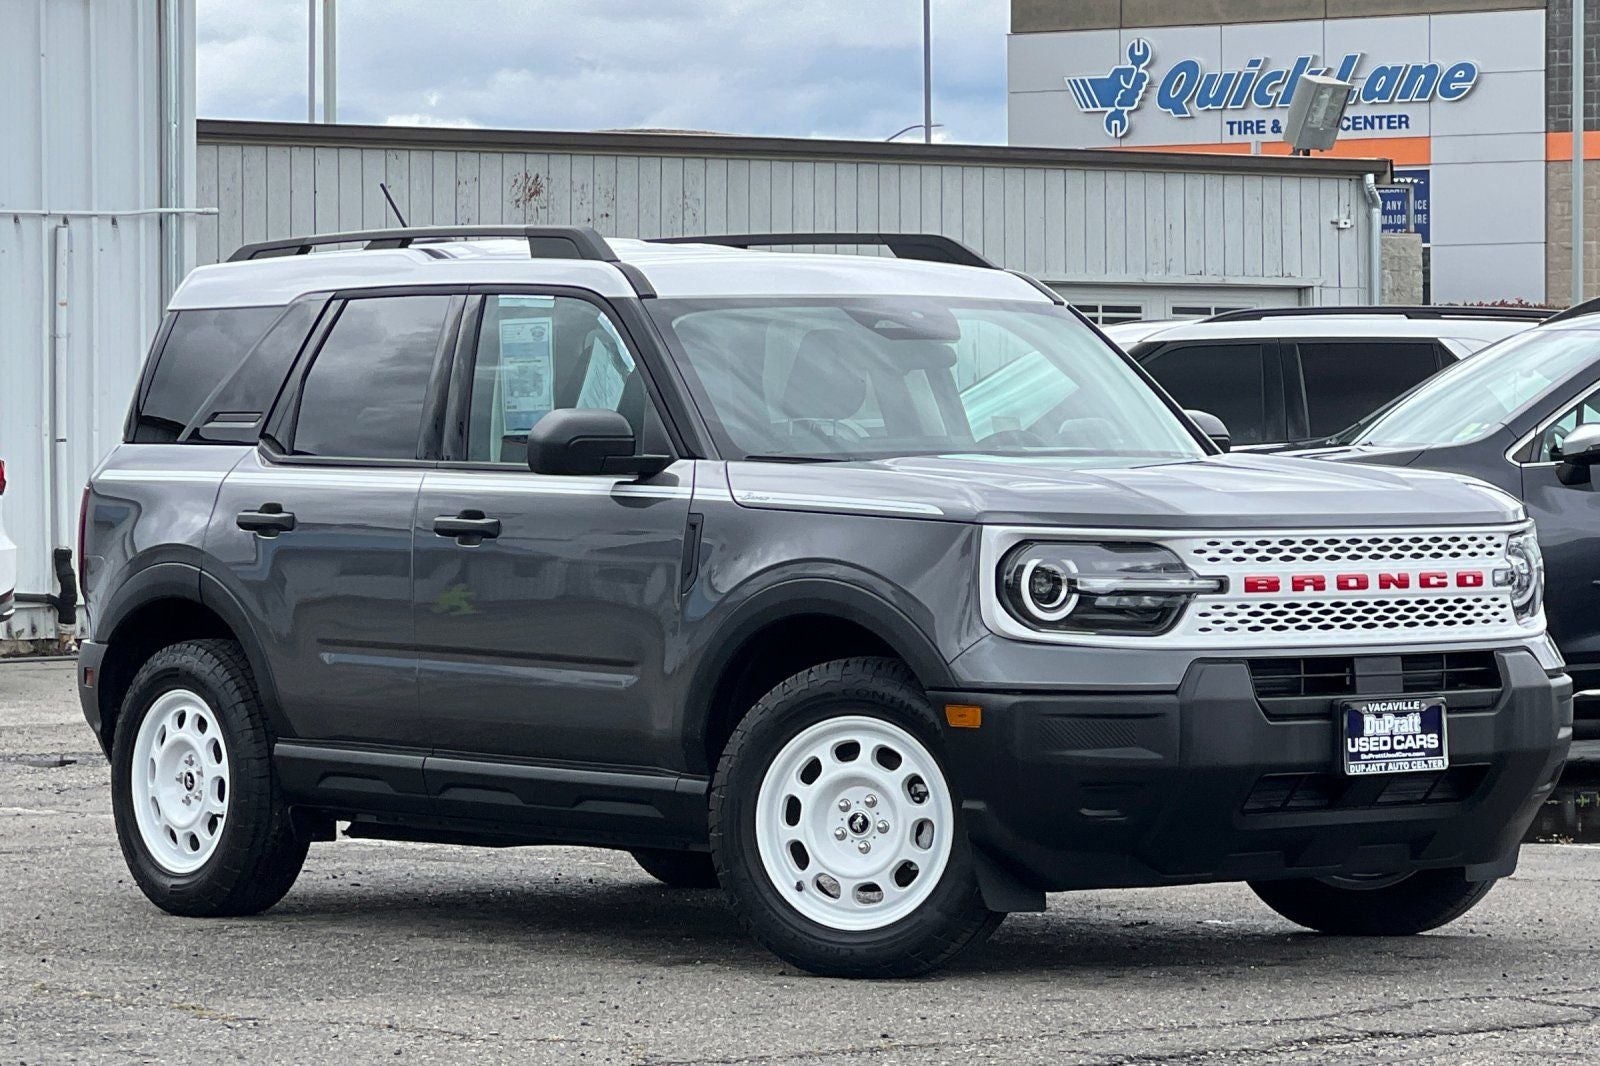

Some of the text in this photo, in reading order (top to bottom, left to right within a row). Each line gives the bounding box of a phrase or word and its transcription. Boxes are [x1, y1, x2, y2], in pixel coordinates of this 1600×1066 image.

[1226, 114, 1410, 136] TIRE & CENTER
[1386, 201, 1402, 210] ANY
[1244, 571, 1484, 593] BRONCO
[1367, 700, 1420, 712] VACAVILLE
[1363, 712, 1422, 736] DuPratt
[1347, 733, 1439, 752] USED CARS
[1387, 761, 1409, 771] AUTO
